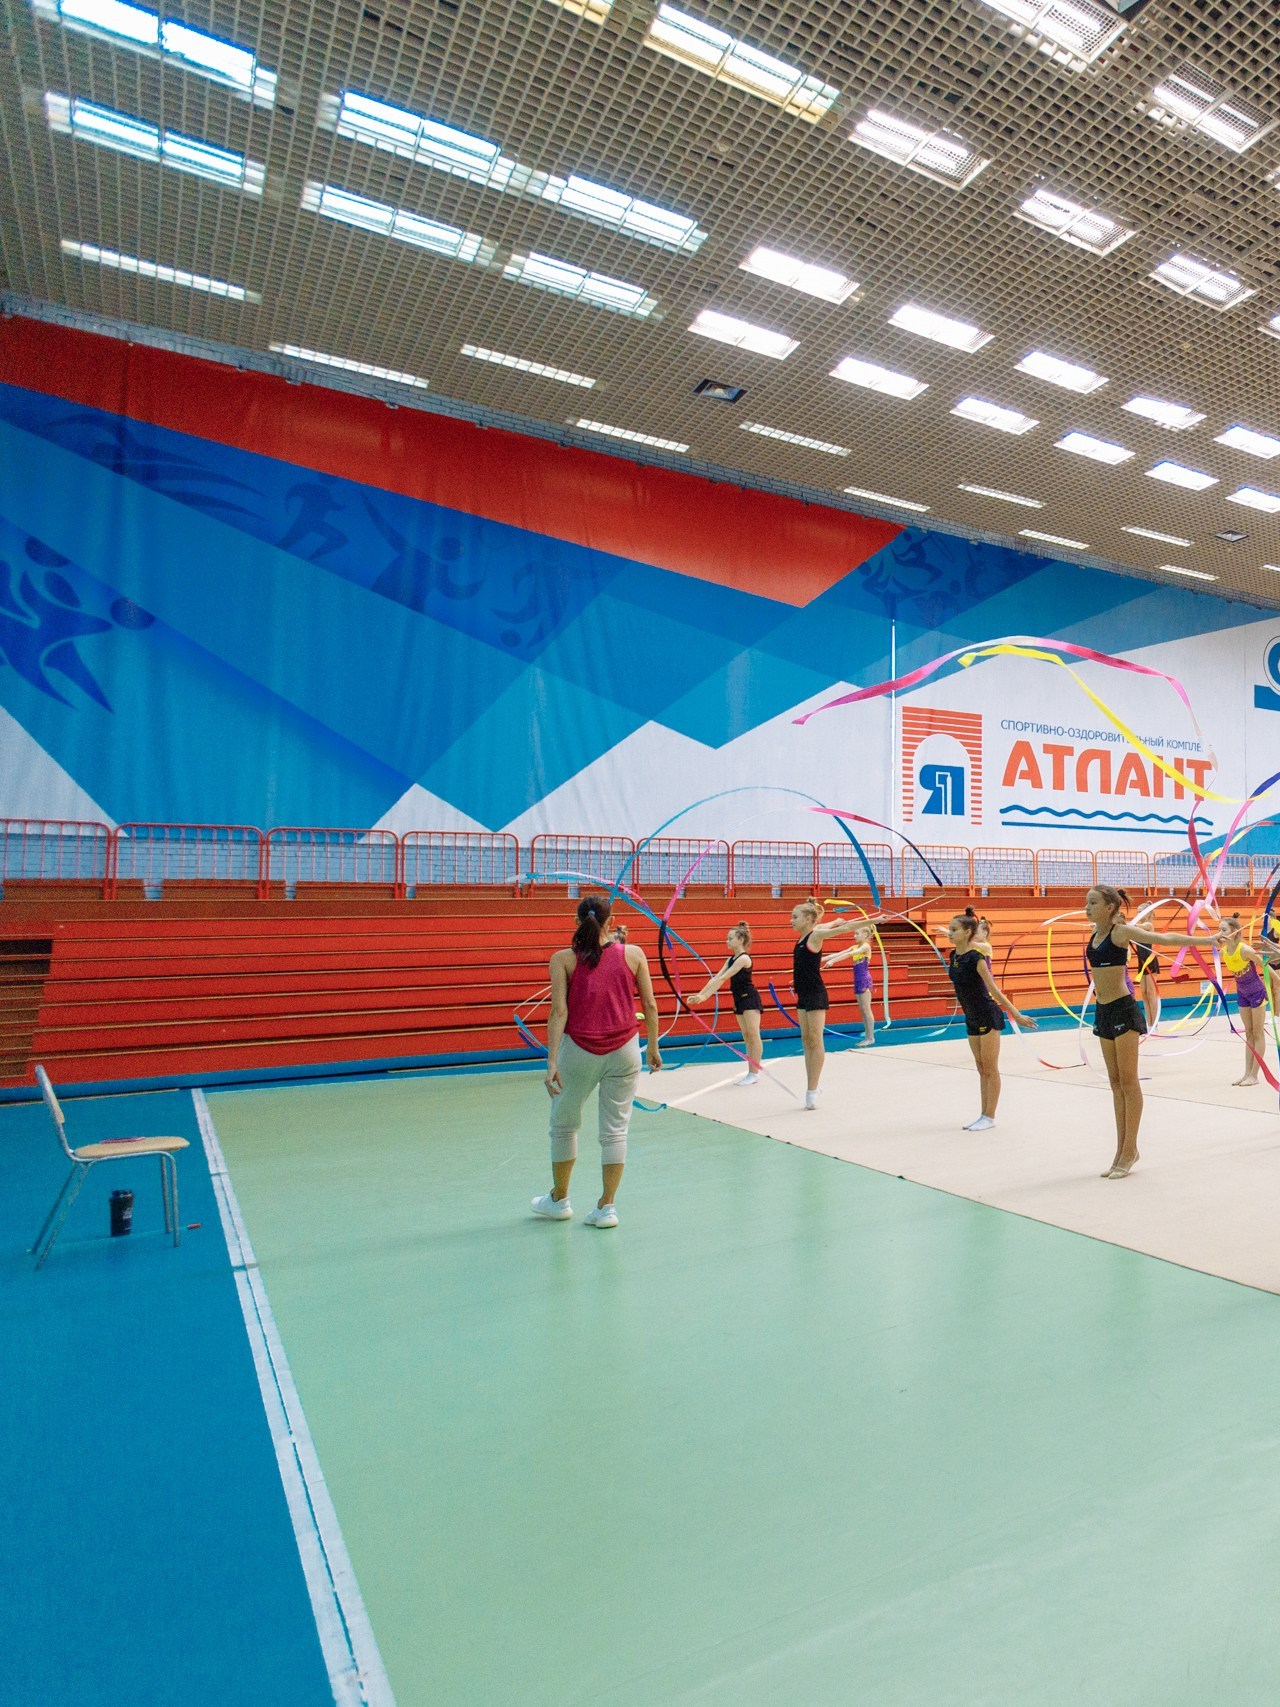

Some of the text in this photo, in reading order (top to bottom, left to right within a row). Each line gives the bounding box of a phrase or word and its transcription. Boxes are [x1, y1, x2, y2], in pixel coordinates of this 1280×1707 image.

[1000, 719, 1212, 752] СПОРТИВНО-ОЗДОРОВИТЬНЫЙ КОМПЛЕ
[1002, 740, 1213, 802] АТЛАНТ
